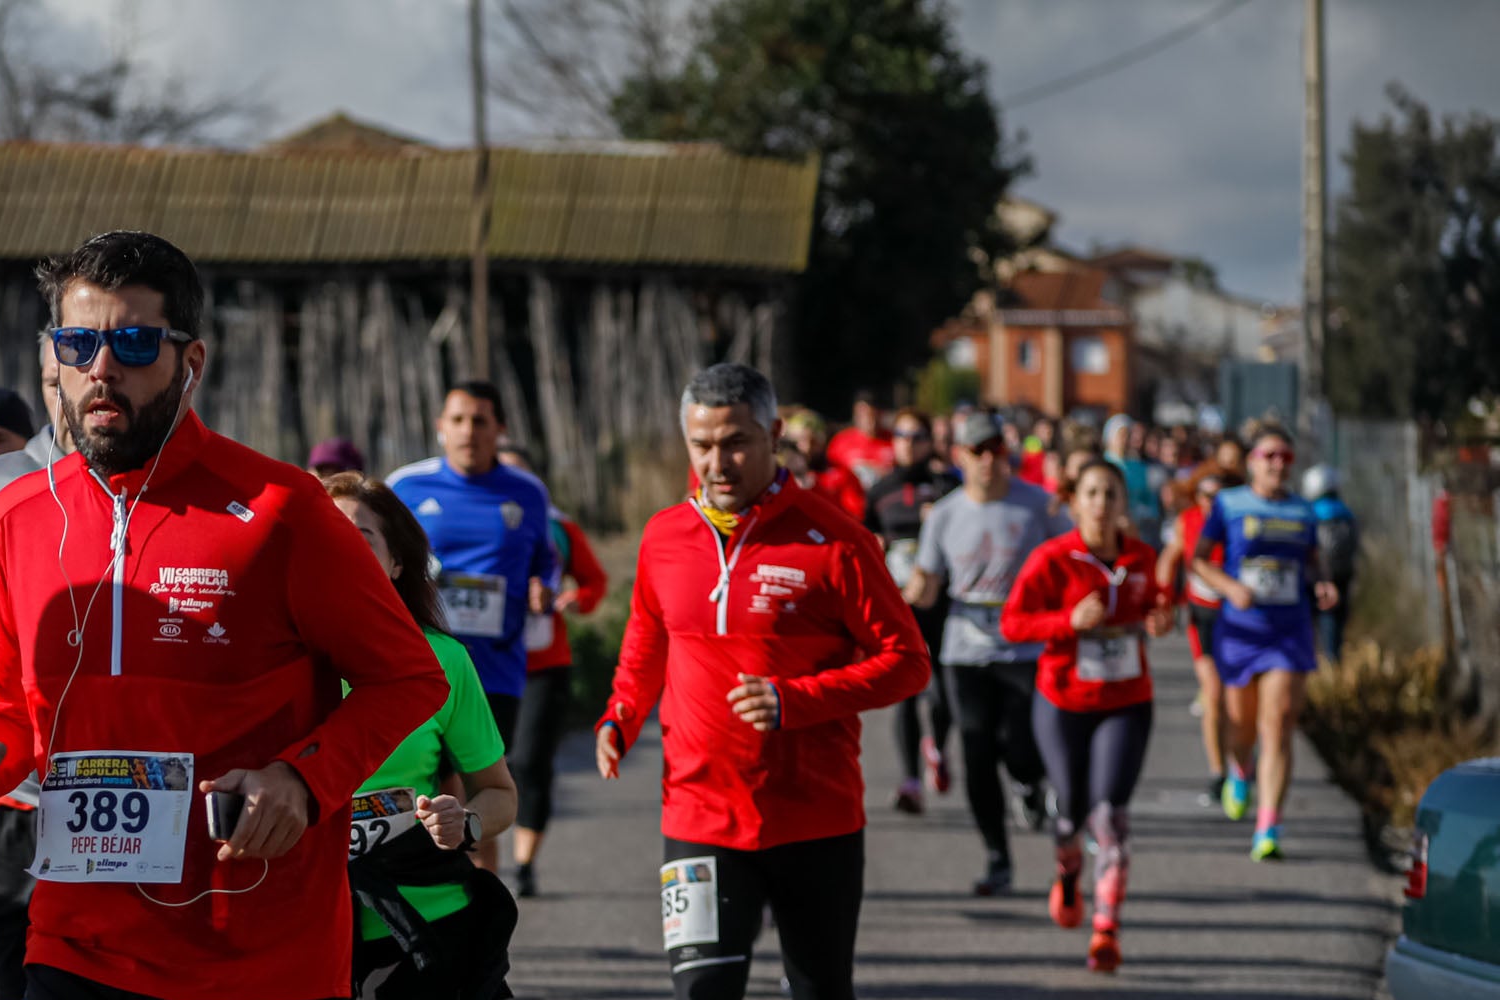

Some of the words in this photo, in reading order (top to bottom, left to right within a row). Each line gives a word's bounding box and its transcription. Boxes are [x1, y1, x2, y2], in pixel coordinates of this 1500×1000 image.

[159, 567, 175, 584] VII
[175, 567, 228, 578] CARRERA
[174, 576, 229, 587] POPULAR
[171, 583, 181, 593] de
[181, 598, 214, 609] olimpo
[163, 626, 177, 634] KIA
[76, 758, 130, 768] CARRERA
[76, 768, 129, 776] POPULAR
[66, 790, 150, 833] 389
[71, 836, 98, 854] PEPE
[101, 833, 142, 854] BÉJAR
[96, 858, 128, 868] olimpo
